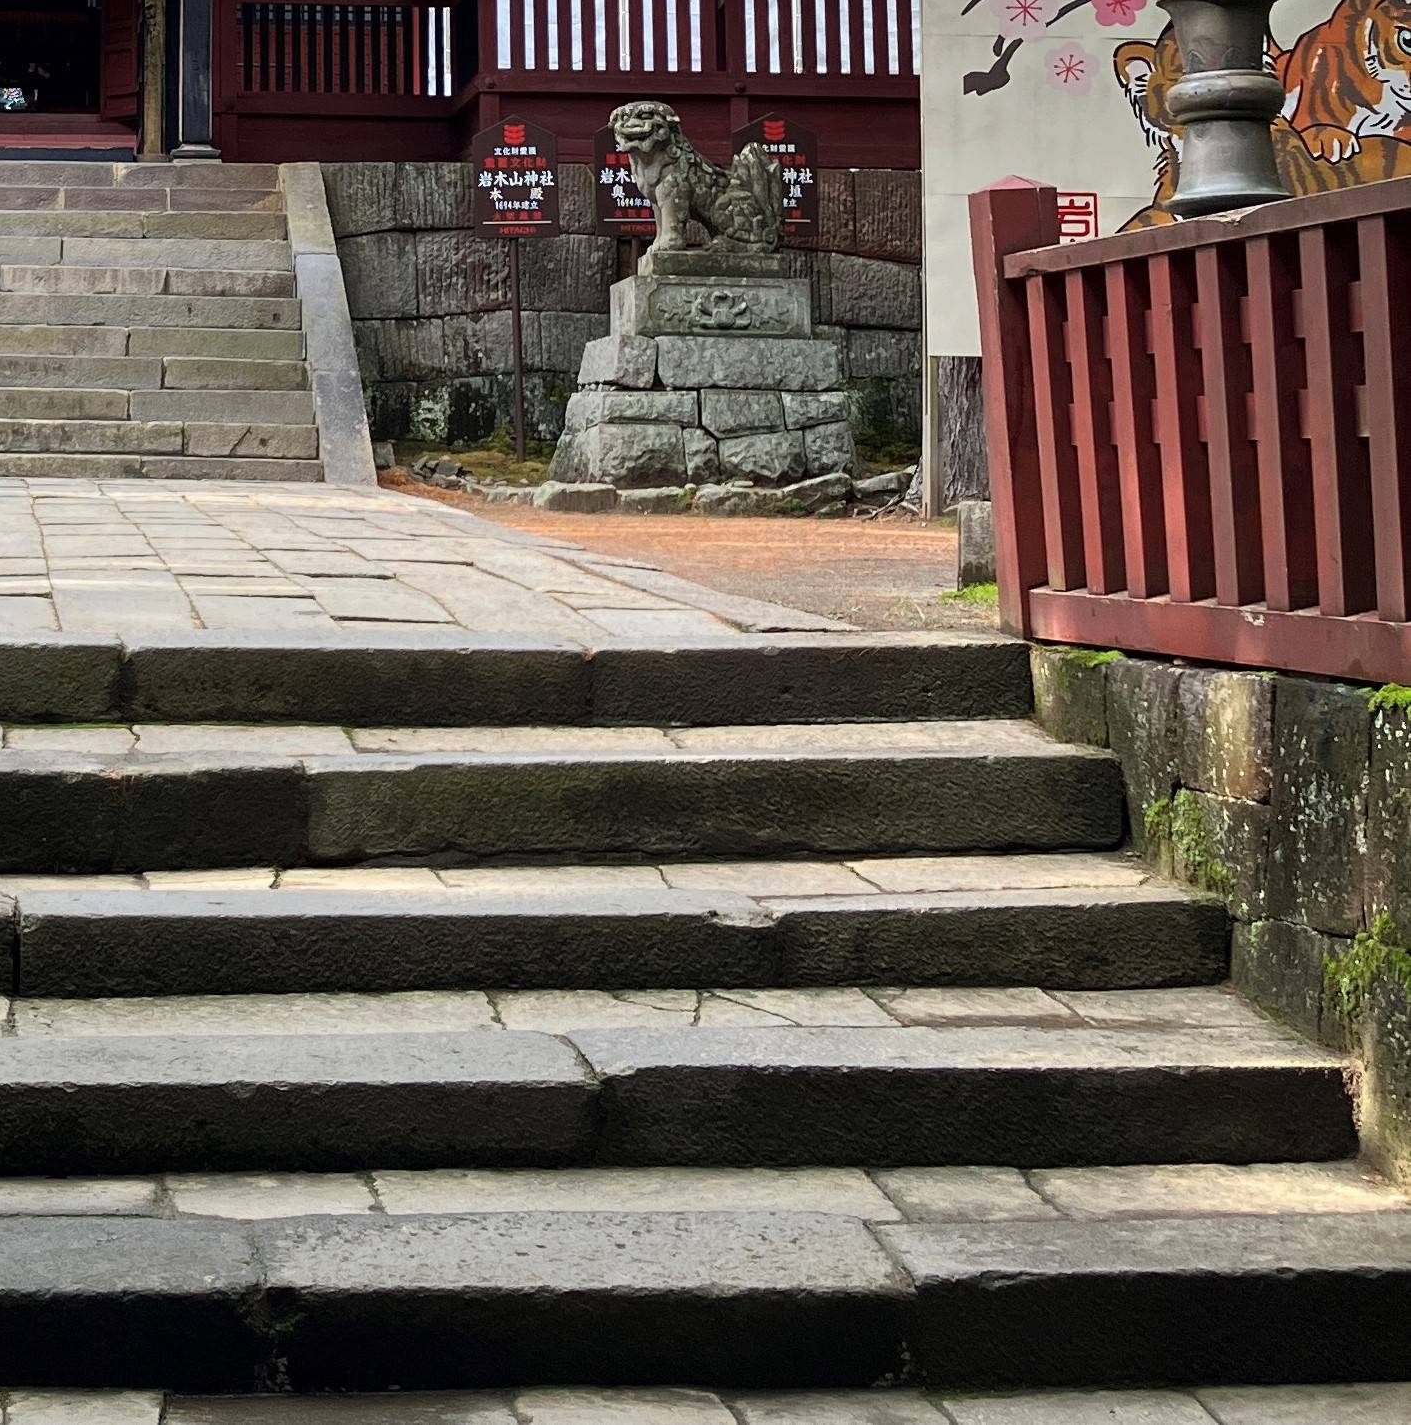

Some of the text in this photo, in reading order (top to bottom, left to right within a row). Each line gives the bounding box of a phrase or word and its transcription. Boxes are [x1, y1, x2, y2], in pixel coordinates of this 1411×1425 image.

[478, 170, 554, 187] 岩木山神社
[782, 167, 813, 184] 神社
[495, 201, 538, 210] 1694年建立
